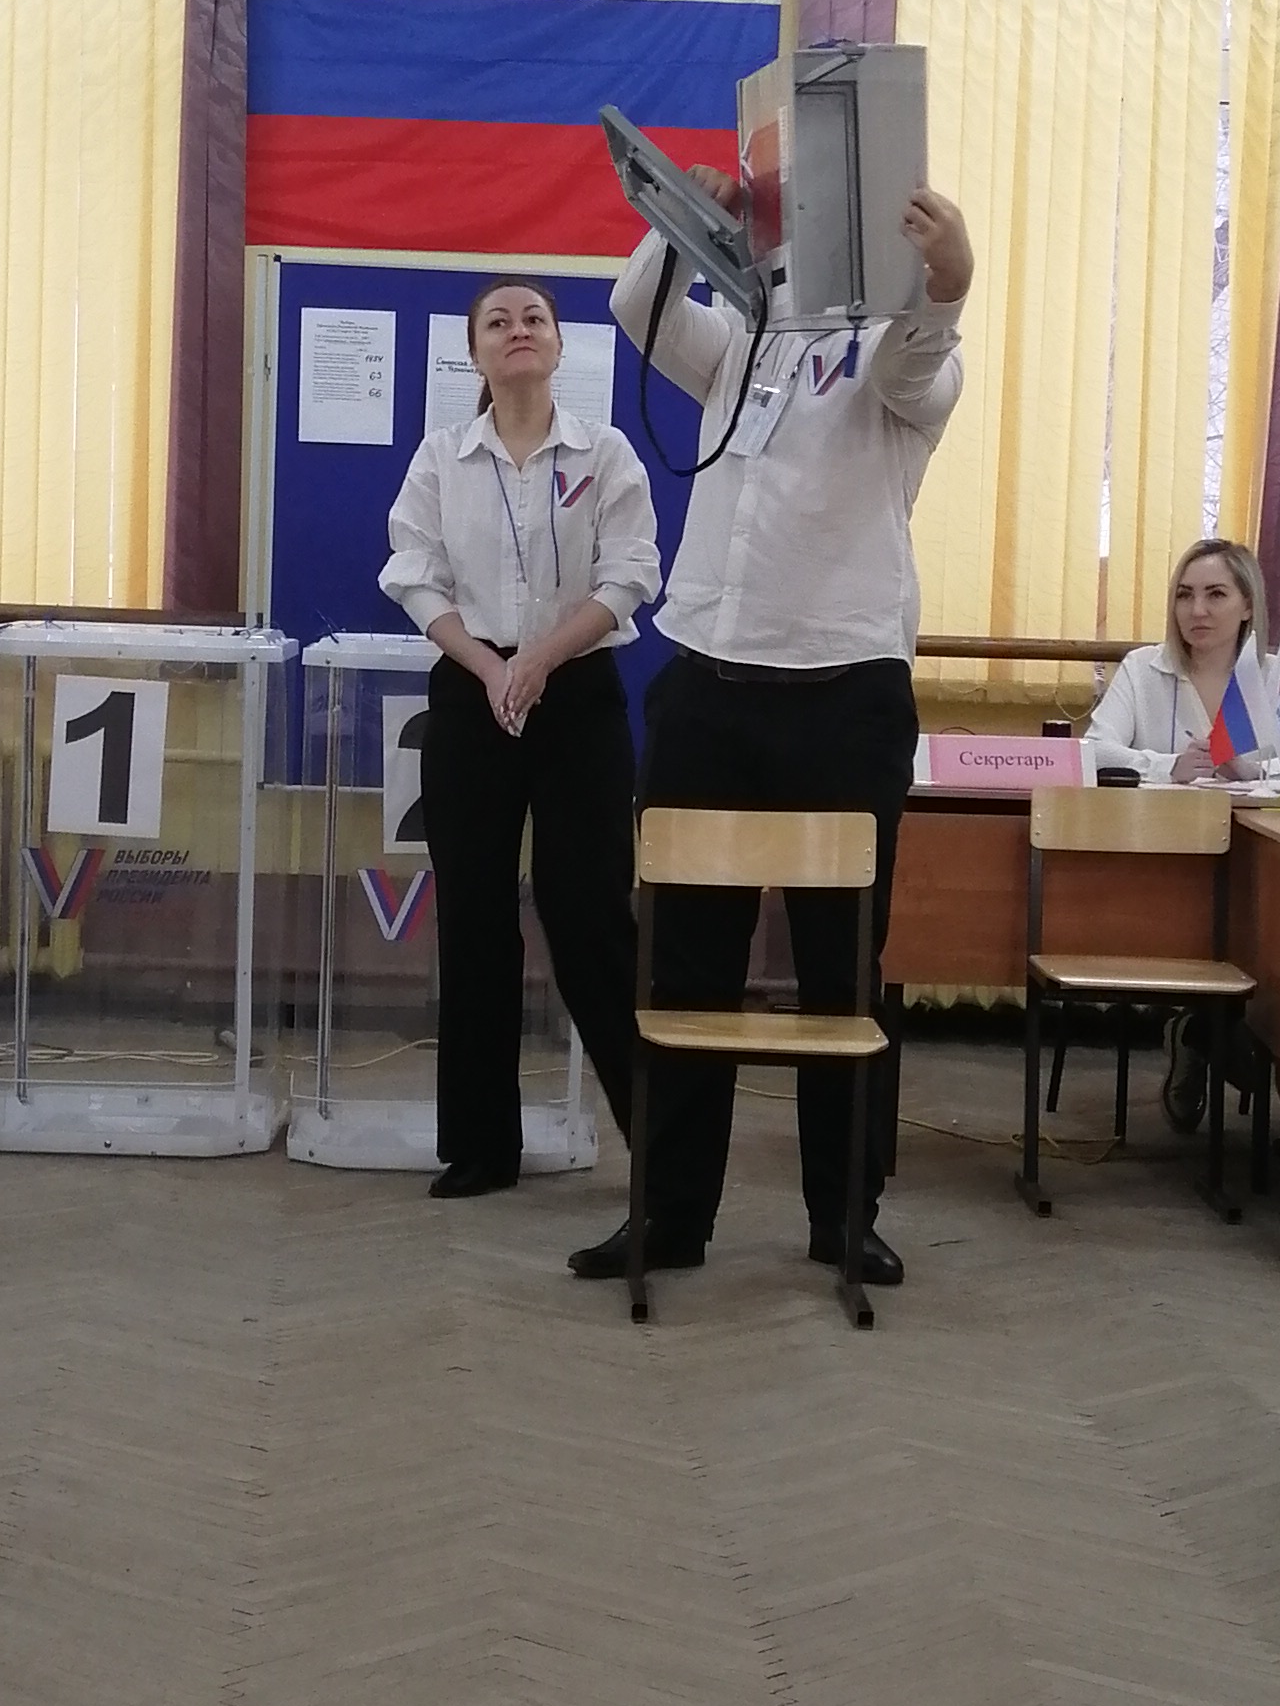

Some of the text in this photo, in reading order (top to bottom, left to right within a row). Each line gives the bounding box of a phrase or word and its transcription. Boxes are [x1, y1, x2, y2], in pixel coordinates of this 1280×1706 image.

[65, 690, 136, 825] 1
[959, 751, 1054, 770] Секретарь
[113, 849, 190, 865] ВЫБОРЫ
[104, 869, 211, 886] ПРЕЗИДЕНТА
